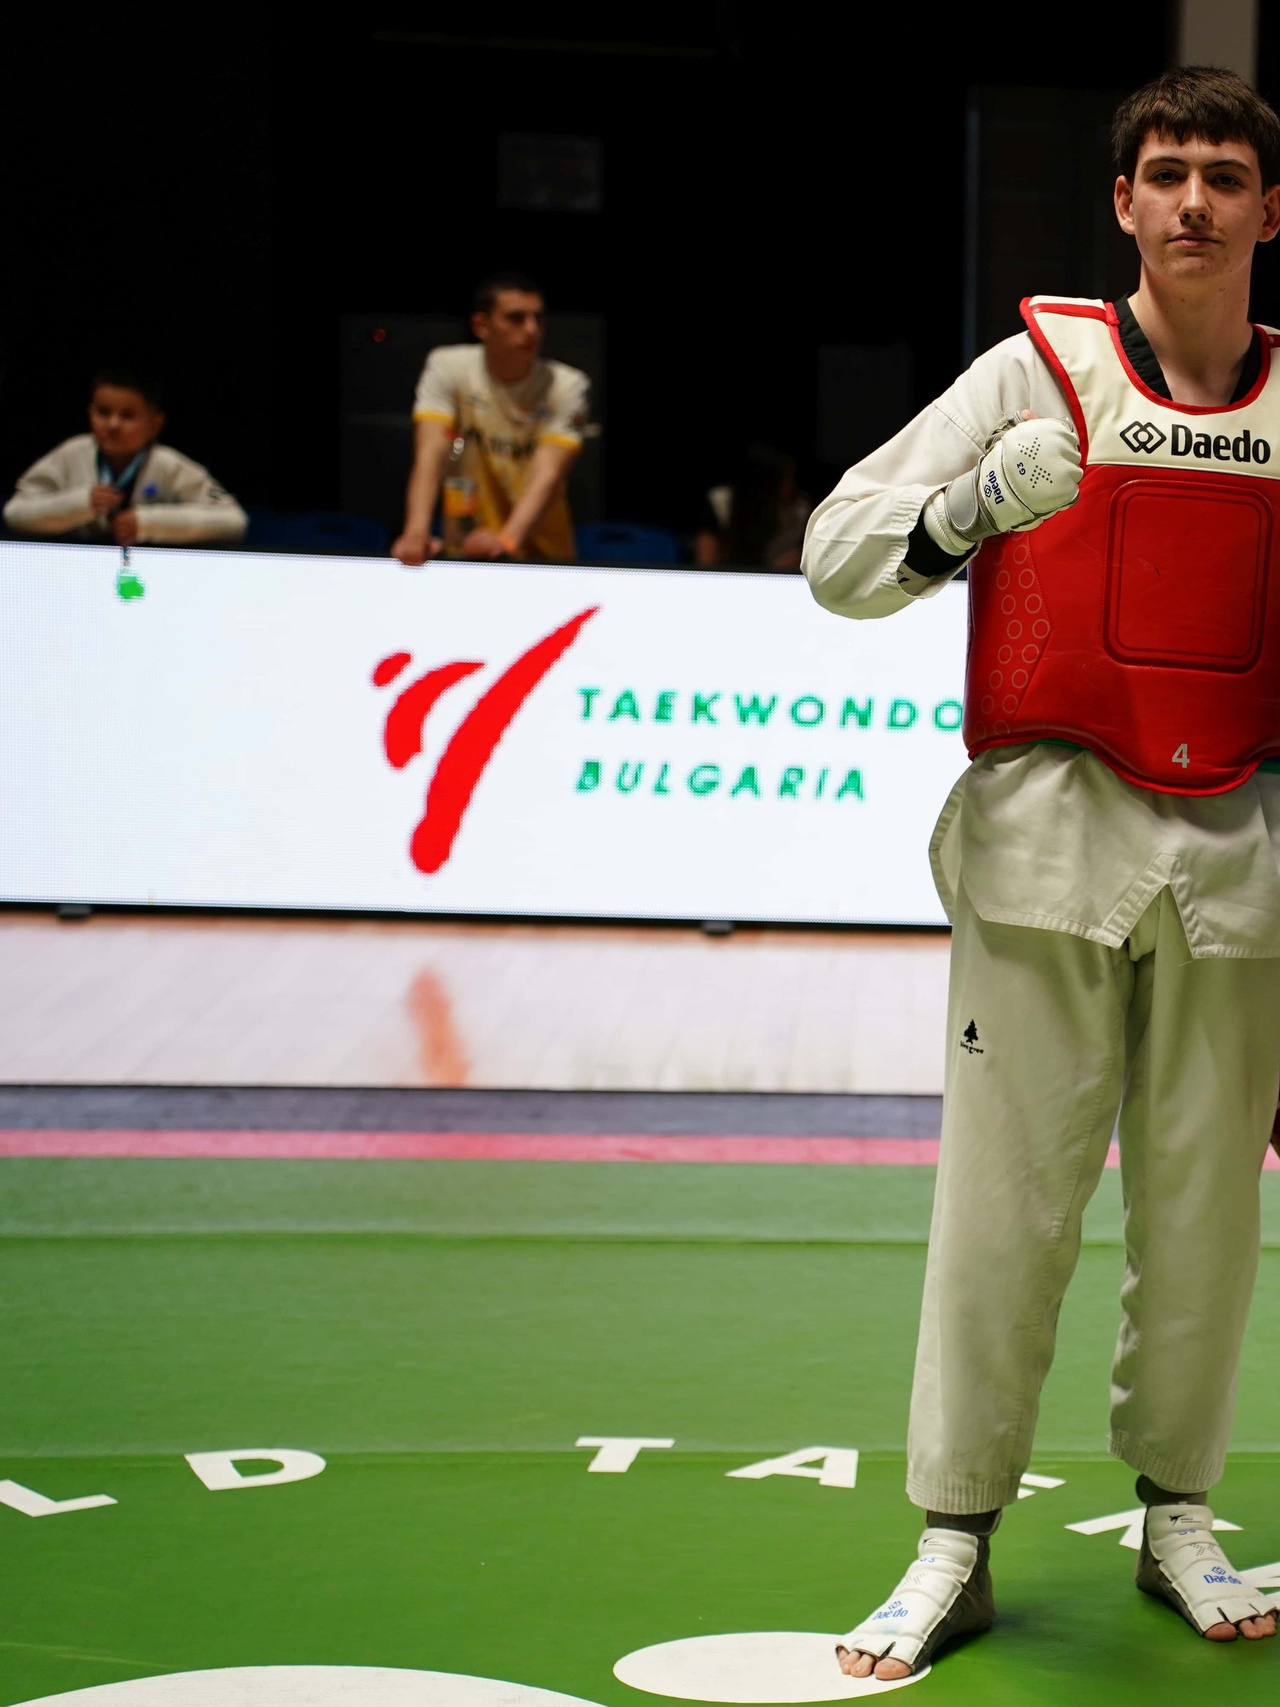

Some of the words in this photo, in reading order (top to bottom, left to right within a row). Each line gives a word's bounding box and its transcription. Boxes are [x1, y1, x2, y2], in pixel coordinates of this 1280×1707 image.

[1171, 423, 1271, 465] Daedo
[988, 470, 1005, 505] Daedo
[1016, 462, 1026, 476] G3
[577, 687, 963, 732] TAEKWONDO
[1171, 743, 1190, 769] 4
[574, 759, 866, 802] BULGARIA
